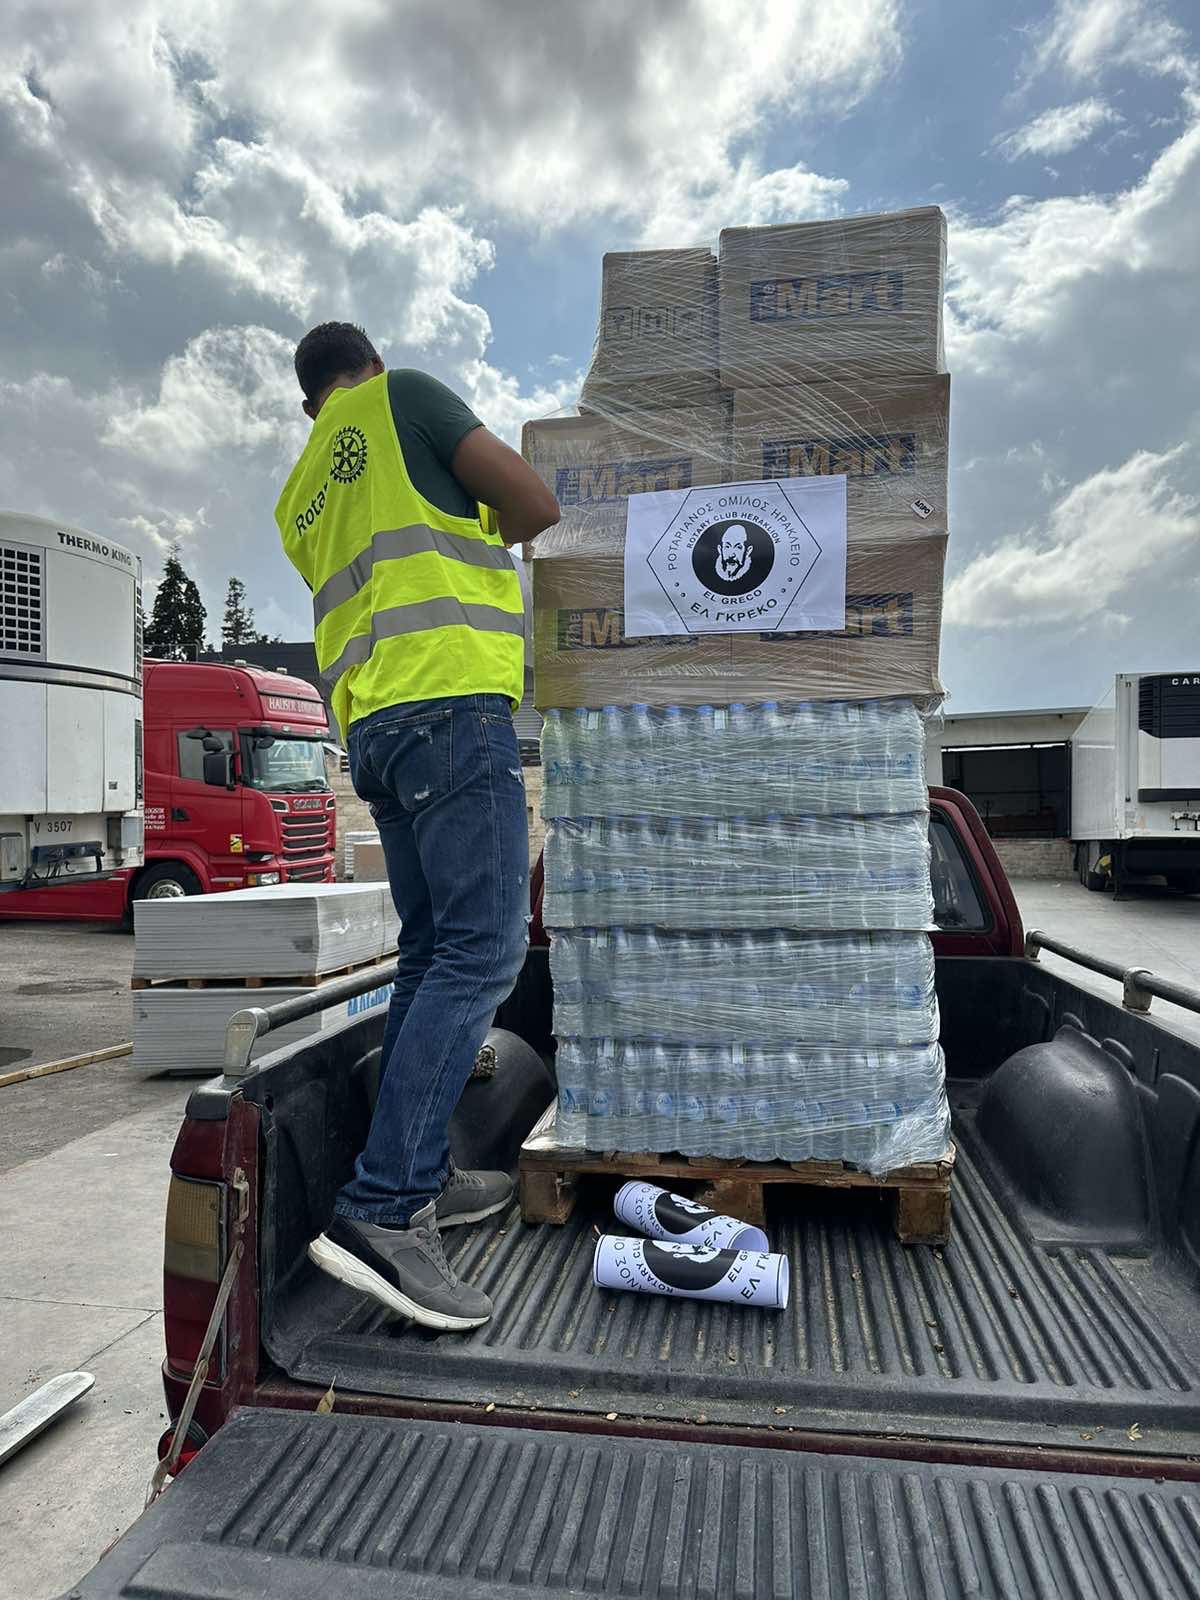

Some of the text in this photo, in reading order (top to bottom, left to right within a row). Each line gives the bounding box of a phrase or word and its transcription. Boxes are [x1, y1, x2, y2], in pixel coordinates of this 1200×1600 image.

[777, 273, 893, 318] Mart
[788, 441, 907, 476] Mart
[579, 464, 681, 497] Mart
[295, 480, 328, 537] Rota
[668, 496, 801, 571] ΡΟΤΑΡΙΑΝΟΣ ΟΜΙΛΟΣ ΗΡΑΚΛΕΙΟ
[686, 511, 781, 549] ROTARY CLUB HERAKLION
[57, 532, 132, 566] THERMO KING
[690, 598, 777, 622] ΕΛ ΓΚΡΕΚΟ
[703, 589, 762, 605] EL GRECO
[34, 820, 73, 833] V 3507
[727, 1266, 743, 1283] EL
